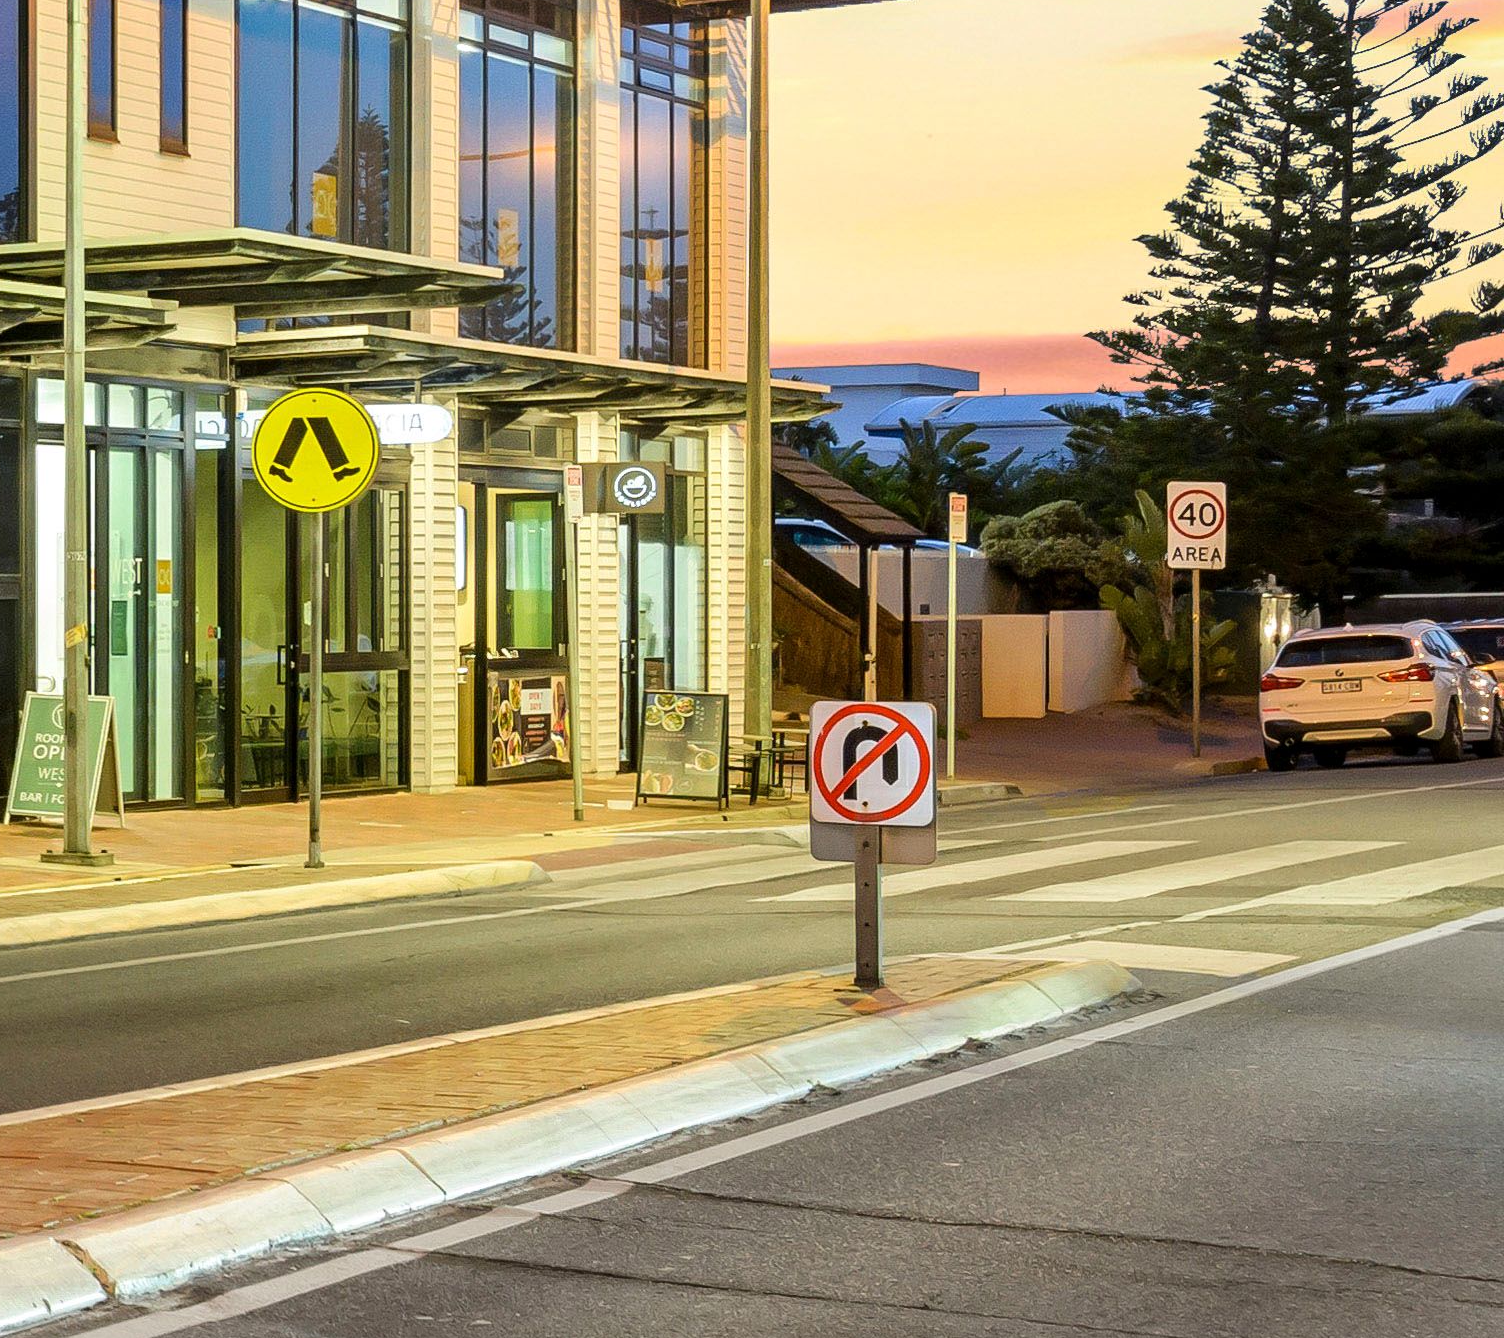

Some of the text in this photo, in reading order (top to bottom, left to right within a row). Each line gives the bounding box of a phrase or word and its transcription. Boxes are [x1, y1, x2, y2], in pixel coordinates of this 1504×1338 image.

[1178, 502, 1217, 527] 40
[1171, 547, 1222, 562] AREA
[20, 792, 43, 802] BAR
